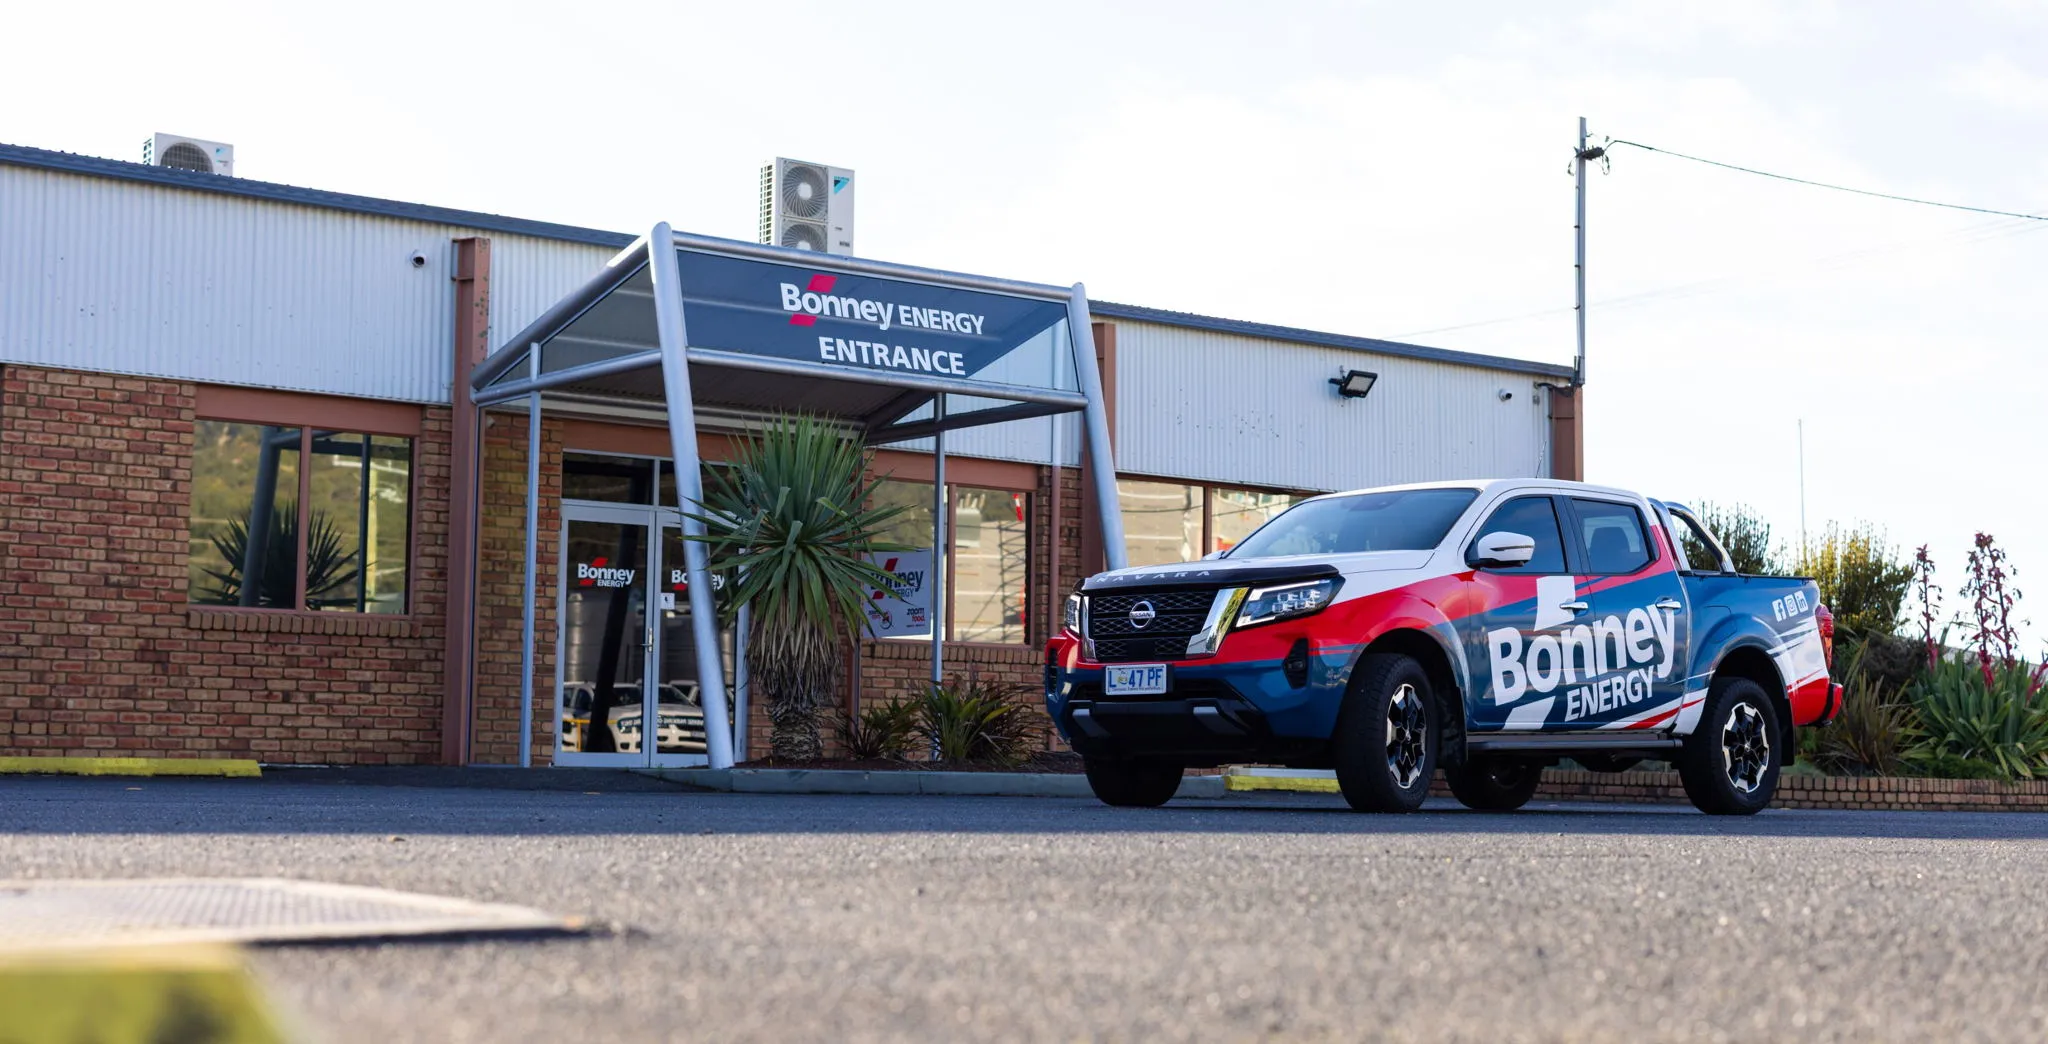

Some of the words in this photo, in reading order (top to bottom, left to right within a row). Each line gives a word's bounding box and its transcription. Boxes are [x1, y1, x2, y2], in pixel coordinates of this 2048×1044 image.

[780, 282, 893, 331] Bonney
[898, 304, 984, 335] ENERGY
[818, 336, 966, 376] ENTRANCE
[577, 563, 635, 585] Bonney
[597, 579, 625, 588] ENERGY
[671, 569, 725, 590] Boey
[1096, 571, 1210, 582] NAVARA
[1488, 604, 1675, 706] Bonney
[1564, 664, 1655, 722] ENERGY
